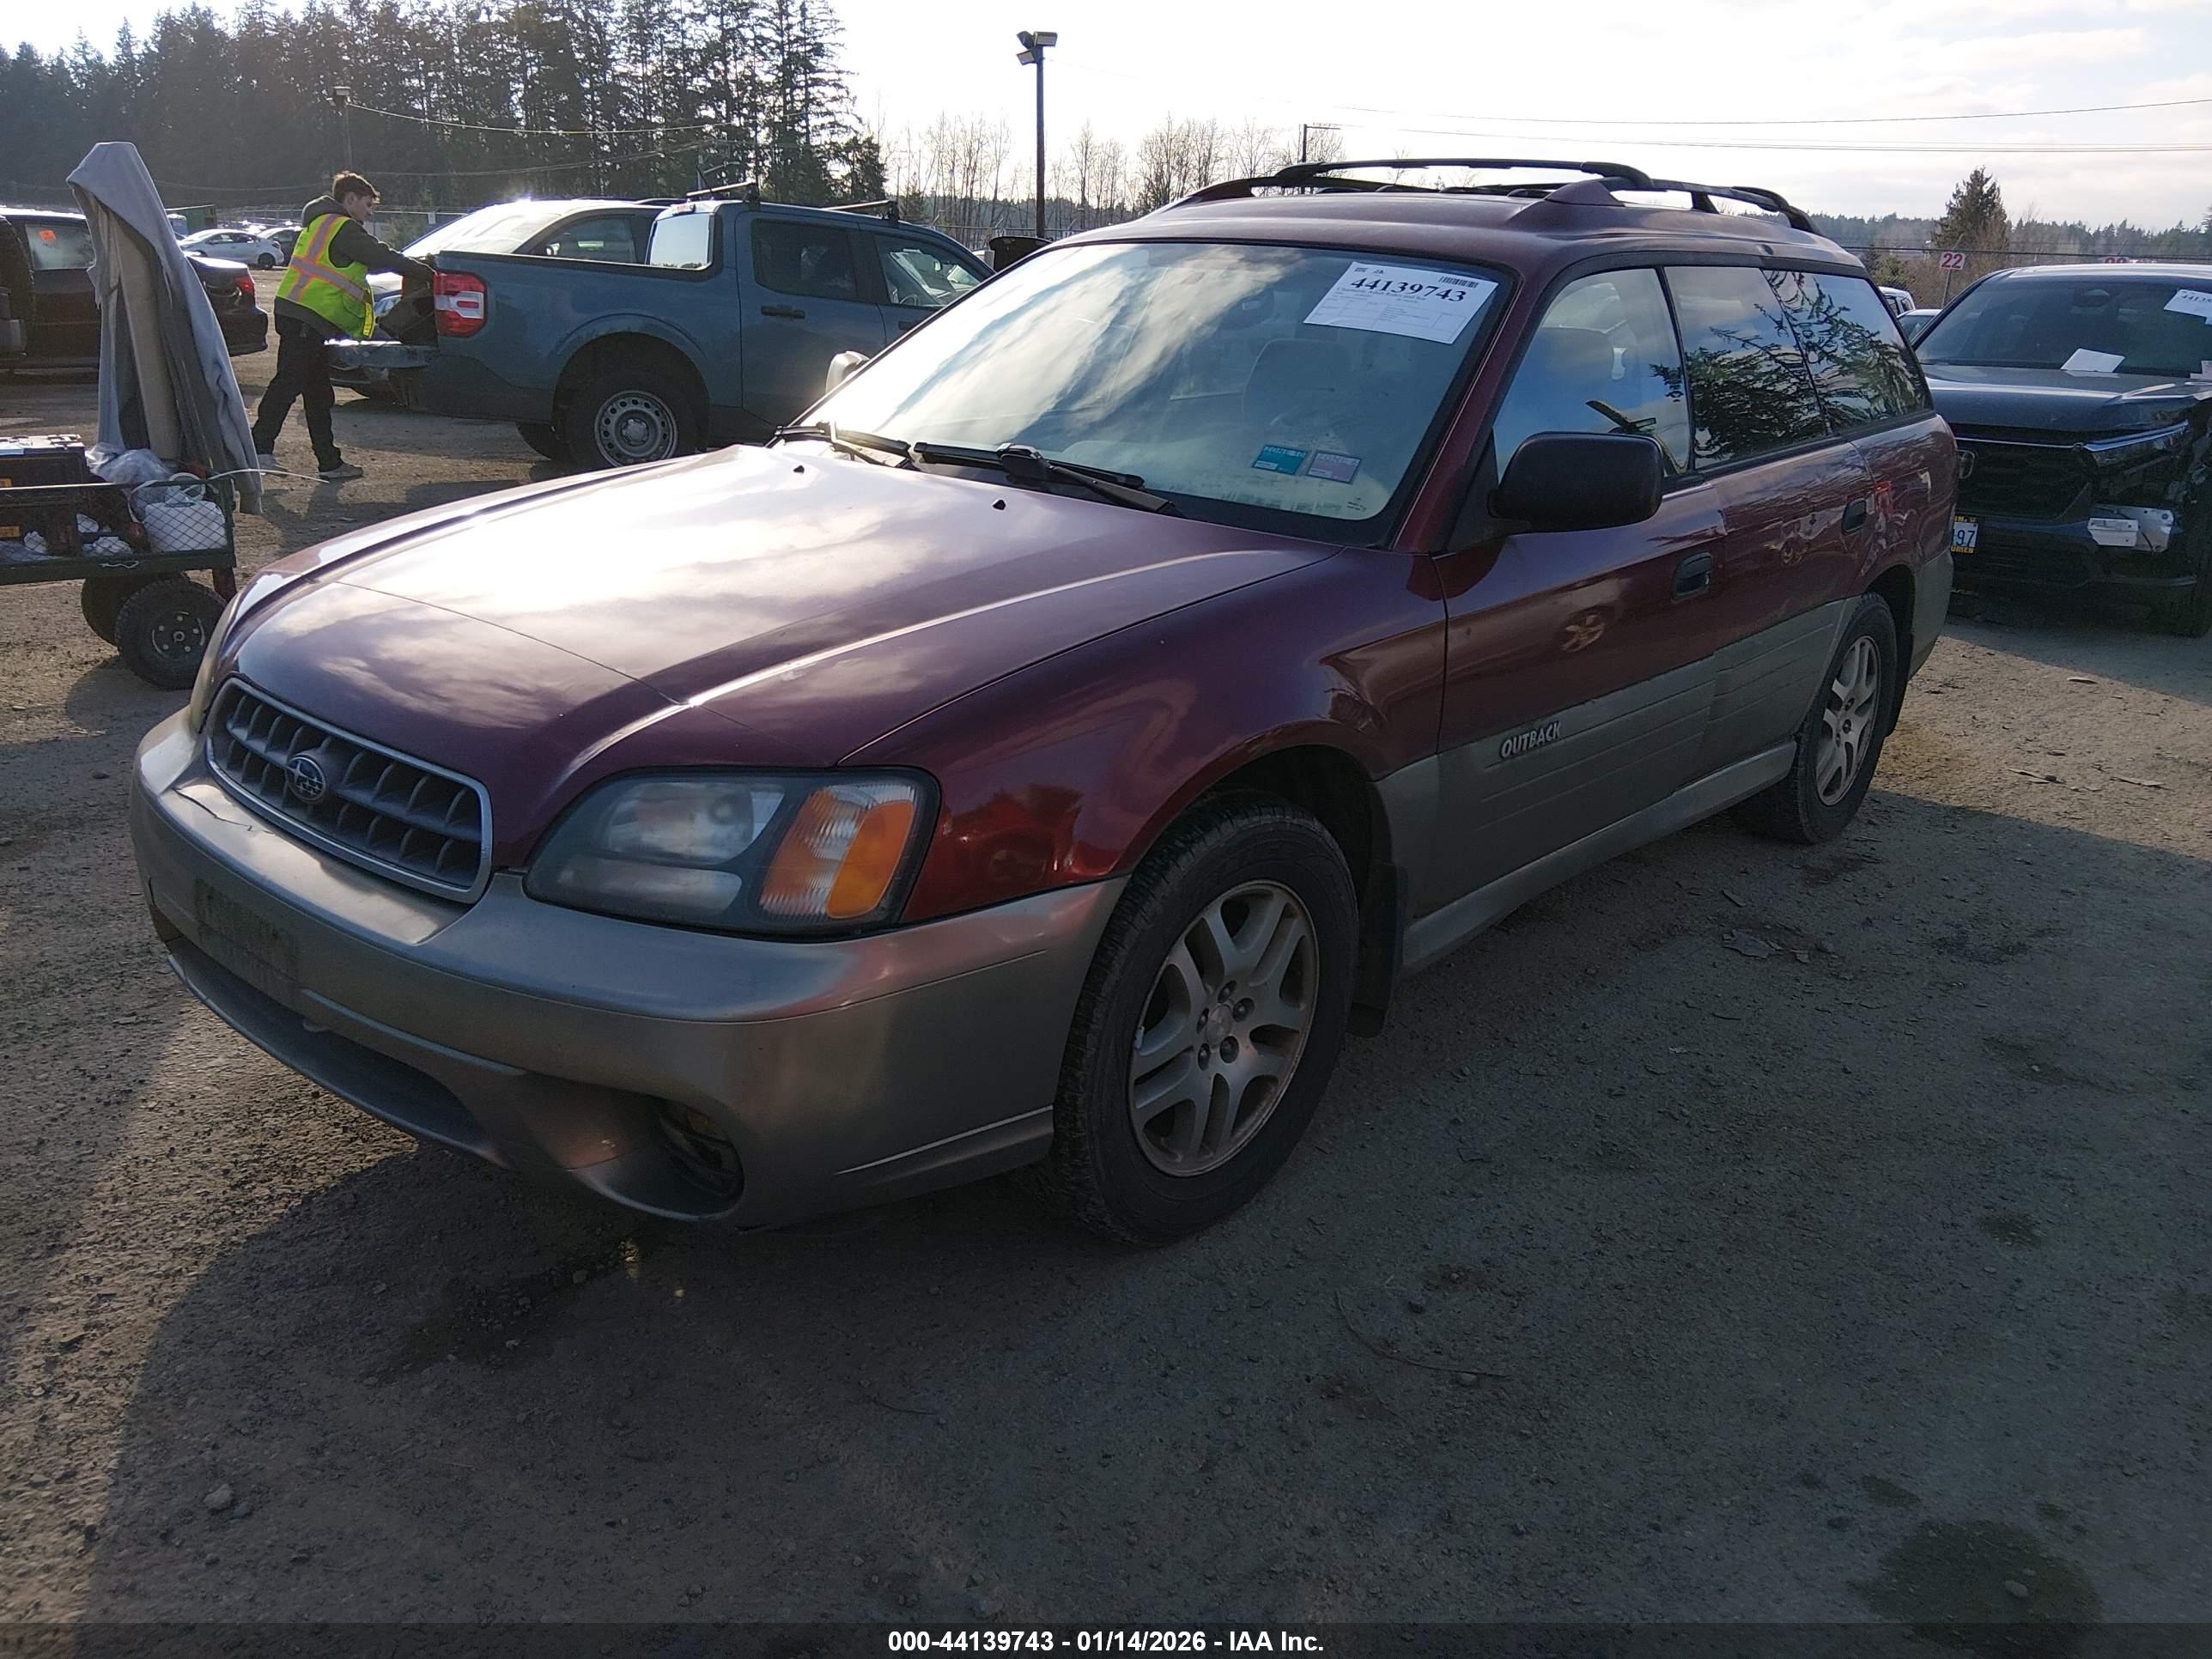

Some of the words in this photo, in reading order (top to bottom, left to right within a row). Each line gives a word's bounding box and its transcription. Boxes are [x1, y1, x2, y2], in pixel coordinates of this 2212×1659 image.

[1942, 253, 1963, 269] 22
[1351, 277, 1467, 302] 44139743
[1501, 721, 1560, 758] OUTBACK
